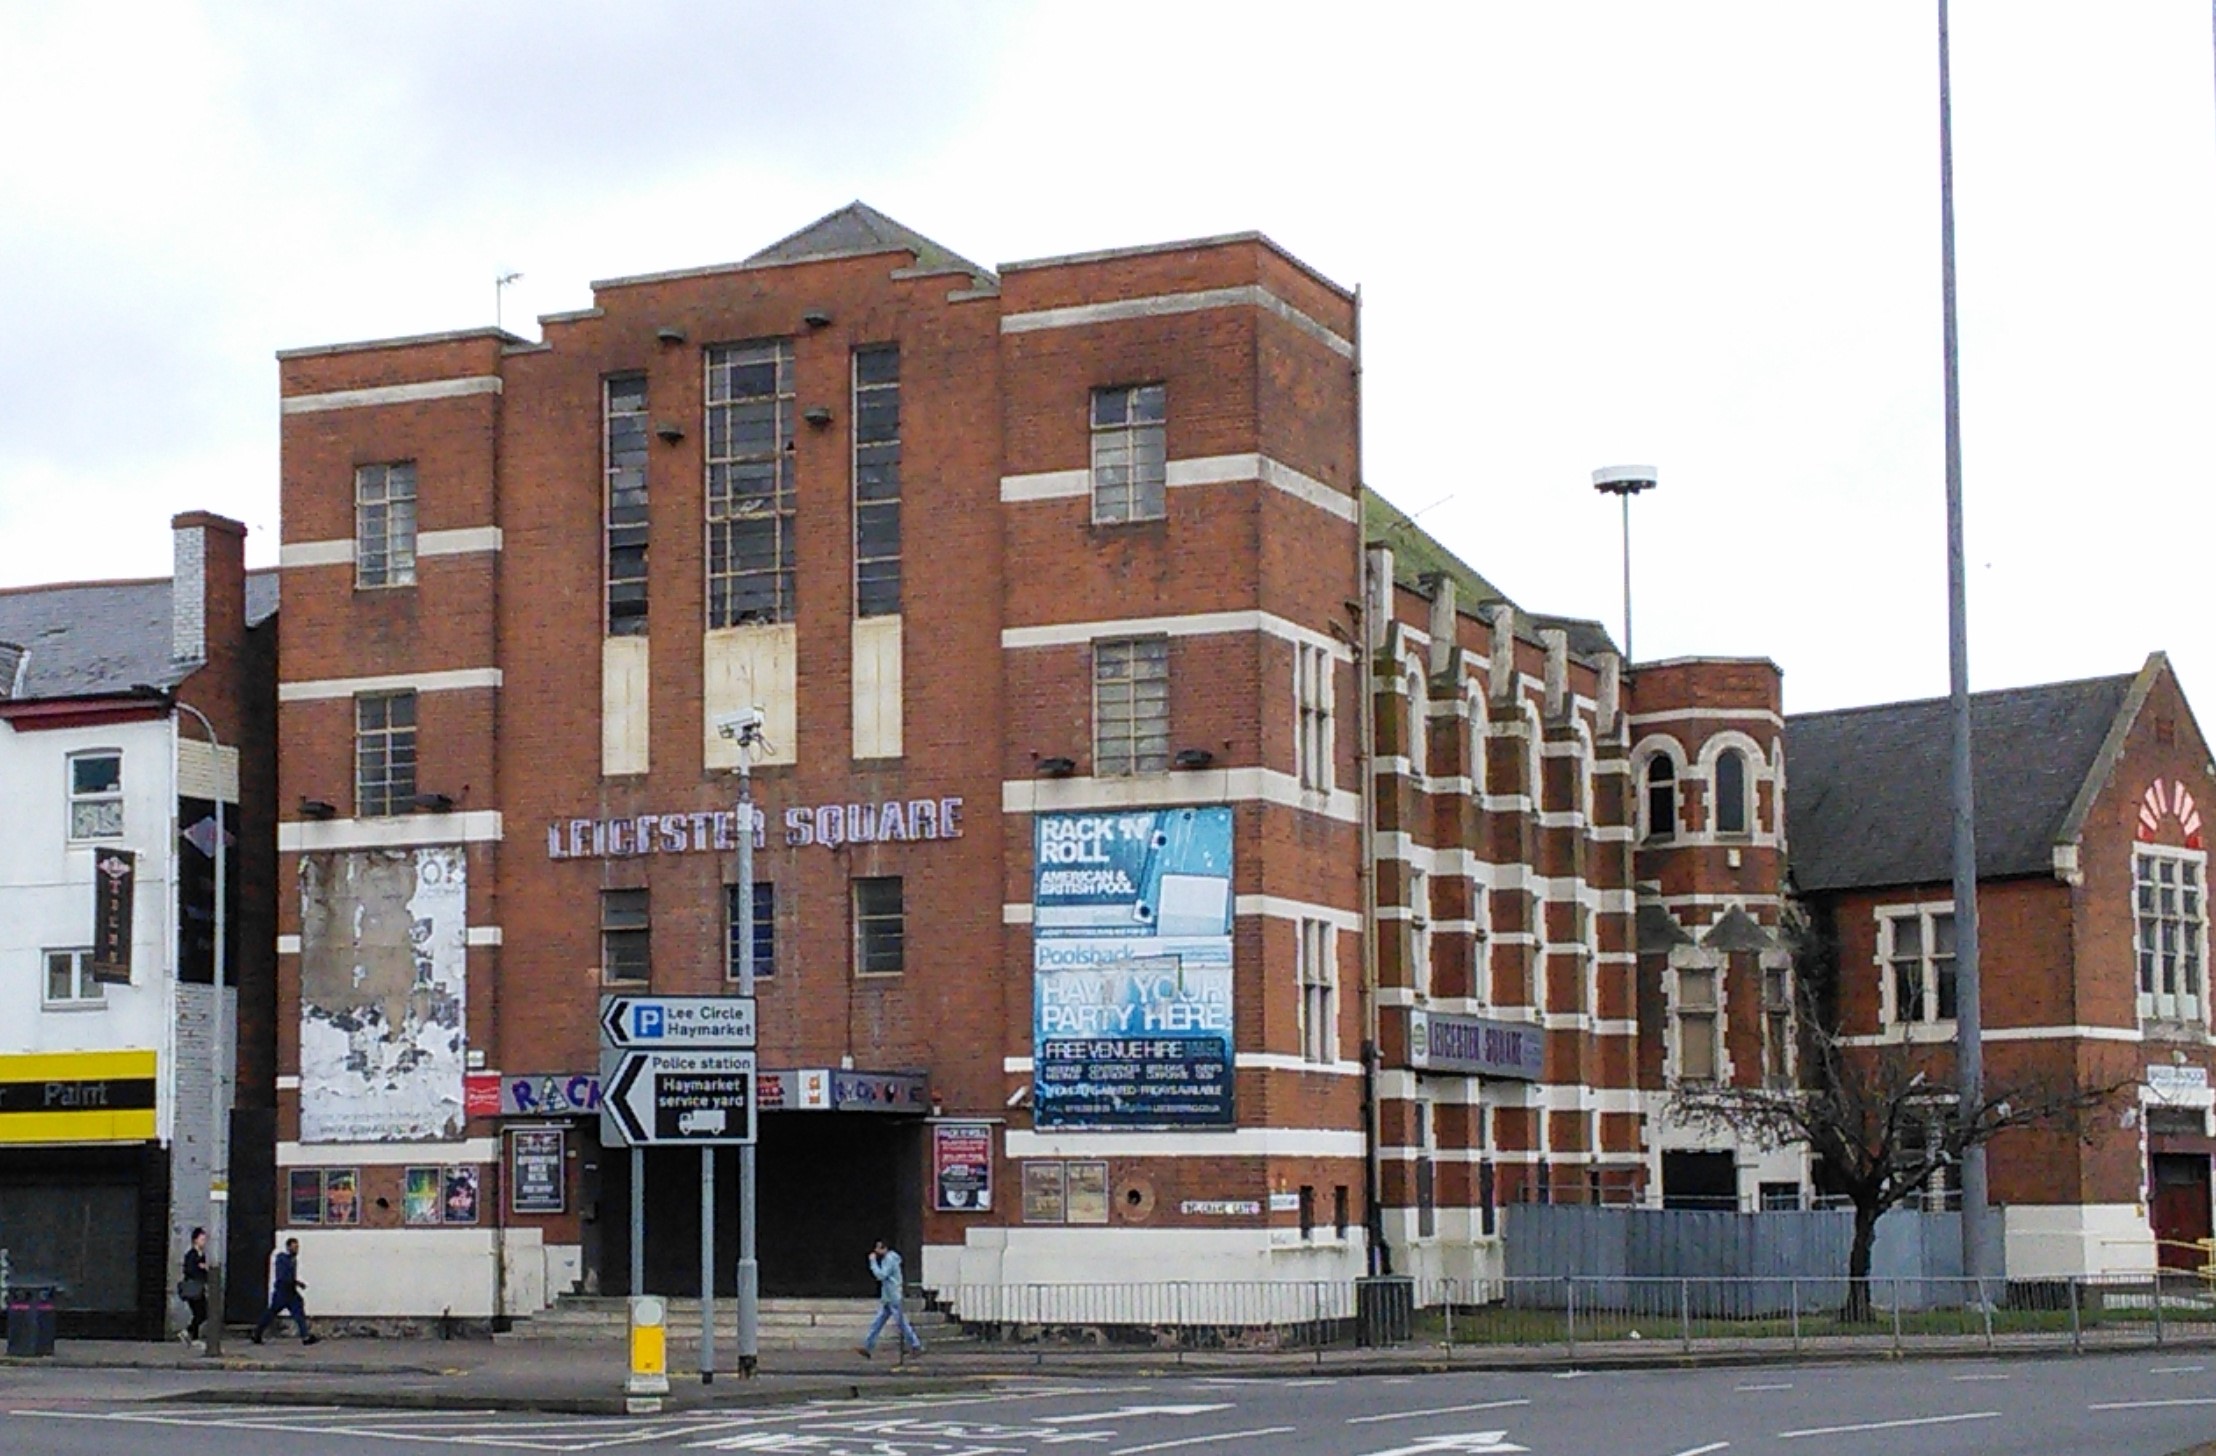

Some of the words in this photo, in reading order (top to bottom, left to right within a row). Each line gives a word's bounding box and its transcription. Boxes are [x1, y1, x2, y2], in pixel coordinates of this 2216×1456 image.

[785, 797, 963, 849] SQUARE
[1040, 818, 1114, 842] RACK
[1040, 841, 1110, 864] ROLL
[1041, 870, 1114, 884] AMERICAN
[1133, 974, 1227, 1003] YOUR
[667, 1008, 694, 1019] Lee
[699, 1006, 744, 1019] Circle
[1042, 1004, 1135, 1031] PARTY
[1144, 1002, 1228, 1030] HERE
[667, 1023, 751, 1038] Haymarket
[1045, 1041, 1087, 1059] FREE
[1089, 1041, 1142, 1059] VENUE
[652, 1056, 697, 1070] Police
[701, 1057, 751, 1070] station
[44, 1081, 109, 1106] Paint
[663, 1077, 741, 1093] Haymarket
[659, 1095, 709, 1108] service
[713, 1096, 744, 1110] yard
